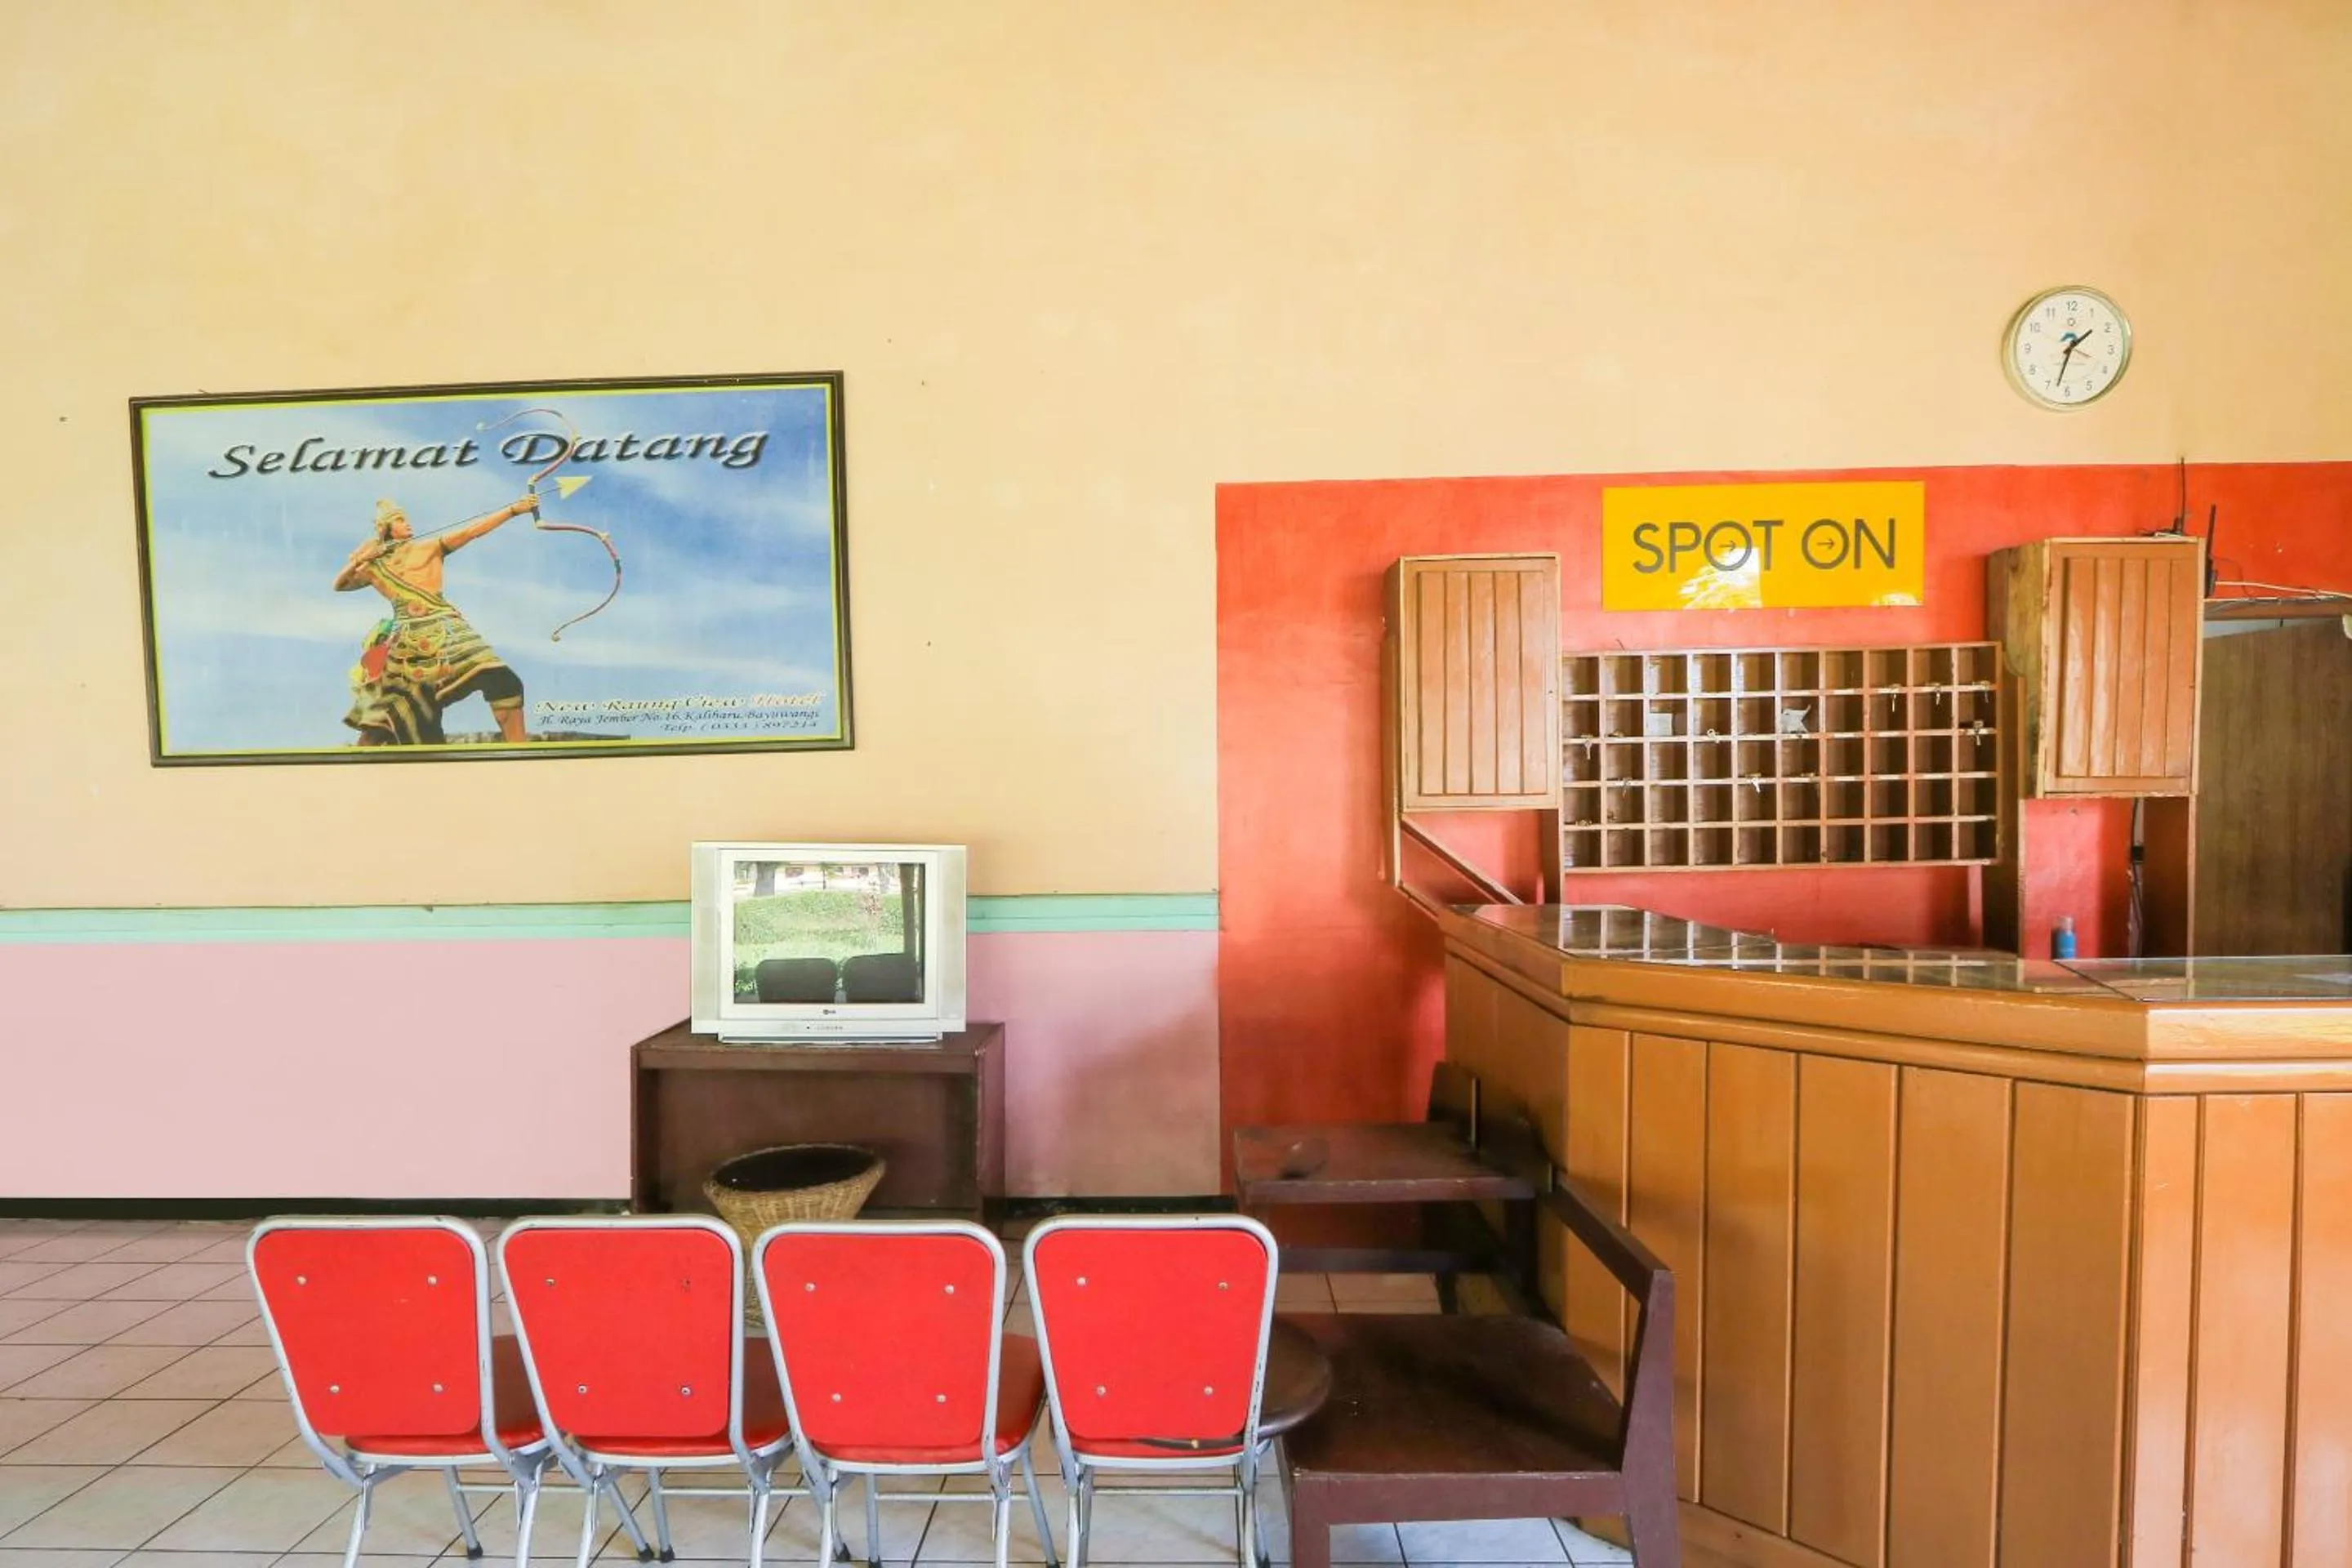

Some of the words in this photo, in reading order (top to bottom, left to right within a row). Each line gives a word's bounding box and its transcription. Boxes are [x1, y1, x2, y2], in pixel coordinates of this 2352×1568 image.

[208, 436, 480, 479] Selamat
[500, 430, 770, 469] Datang
[1632, 519, 1784, 573] SPOT
[1802, 519, 1896, 570] ON
